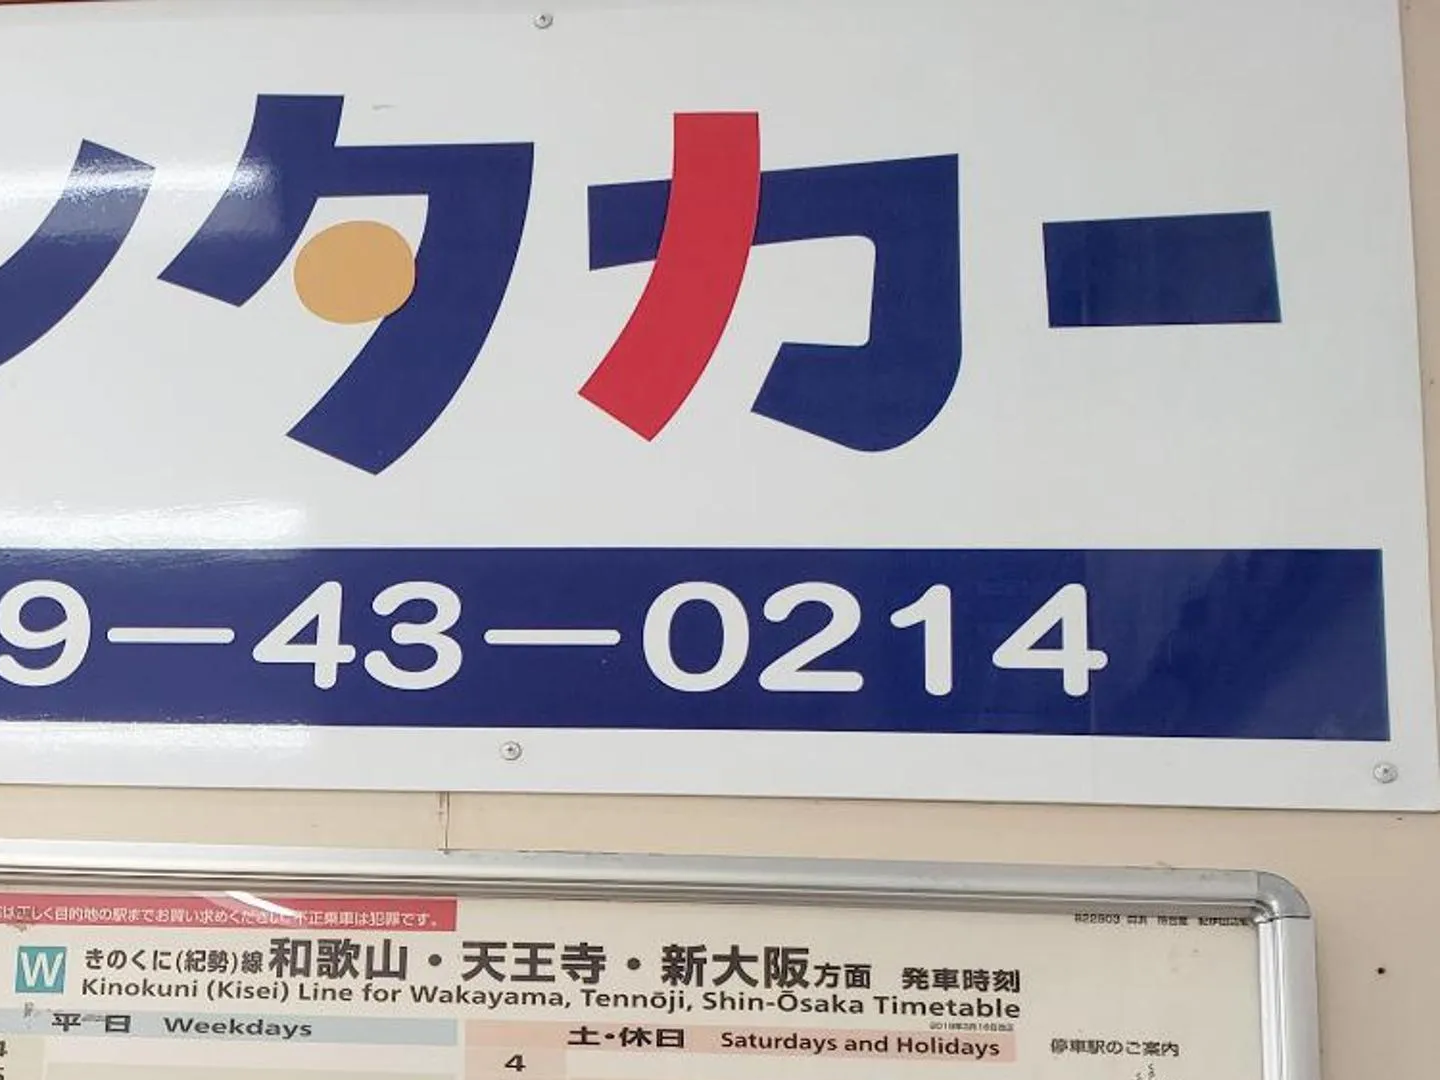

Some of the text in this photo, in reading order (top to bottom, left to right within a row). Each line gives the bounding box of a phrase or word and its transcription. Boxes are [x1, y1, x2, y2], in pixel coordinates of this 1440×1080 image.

[20, 951, 66, 988] W
[83, 947, 264, 976] きのくに(紀勢)線
[901, 966, 1021, 994] 発車時刻
[81, 977, 200, 998] Kinokuni
[207, 979, 290, 1003] (Kisei)
[298, 982, 354, 1002] Line
[361, 984, 398, 1004] for
[402, 984, 571, 1011] Wakayama,
[872, 994, 1021, 1019] Timetable
[51, 1012, 132, 1034] 平日
[163, 1016, 313, 1039] Weekdays
[720, 1030, 1000, 1058] Saturdays and Holidays
[1050, 1038, 1180, 1059] 停車駅のご案内
[505, 1055, 525, 1071] 4
